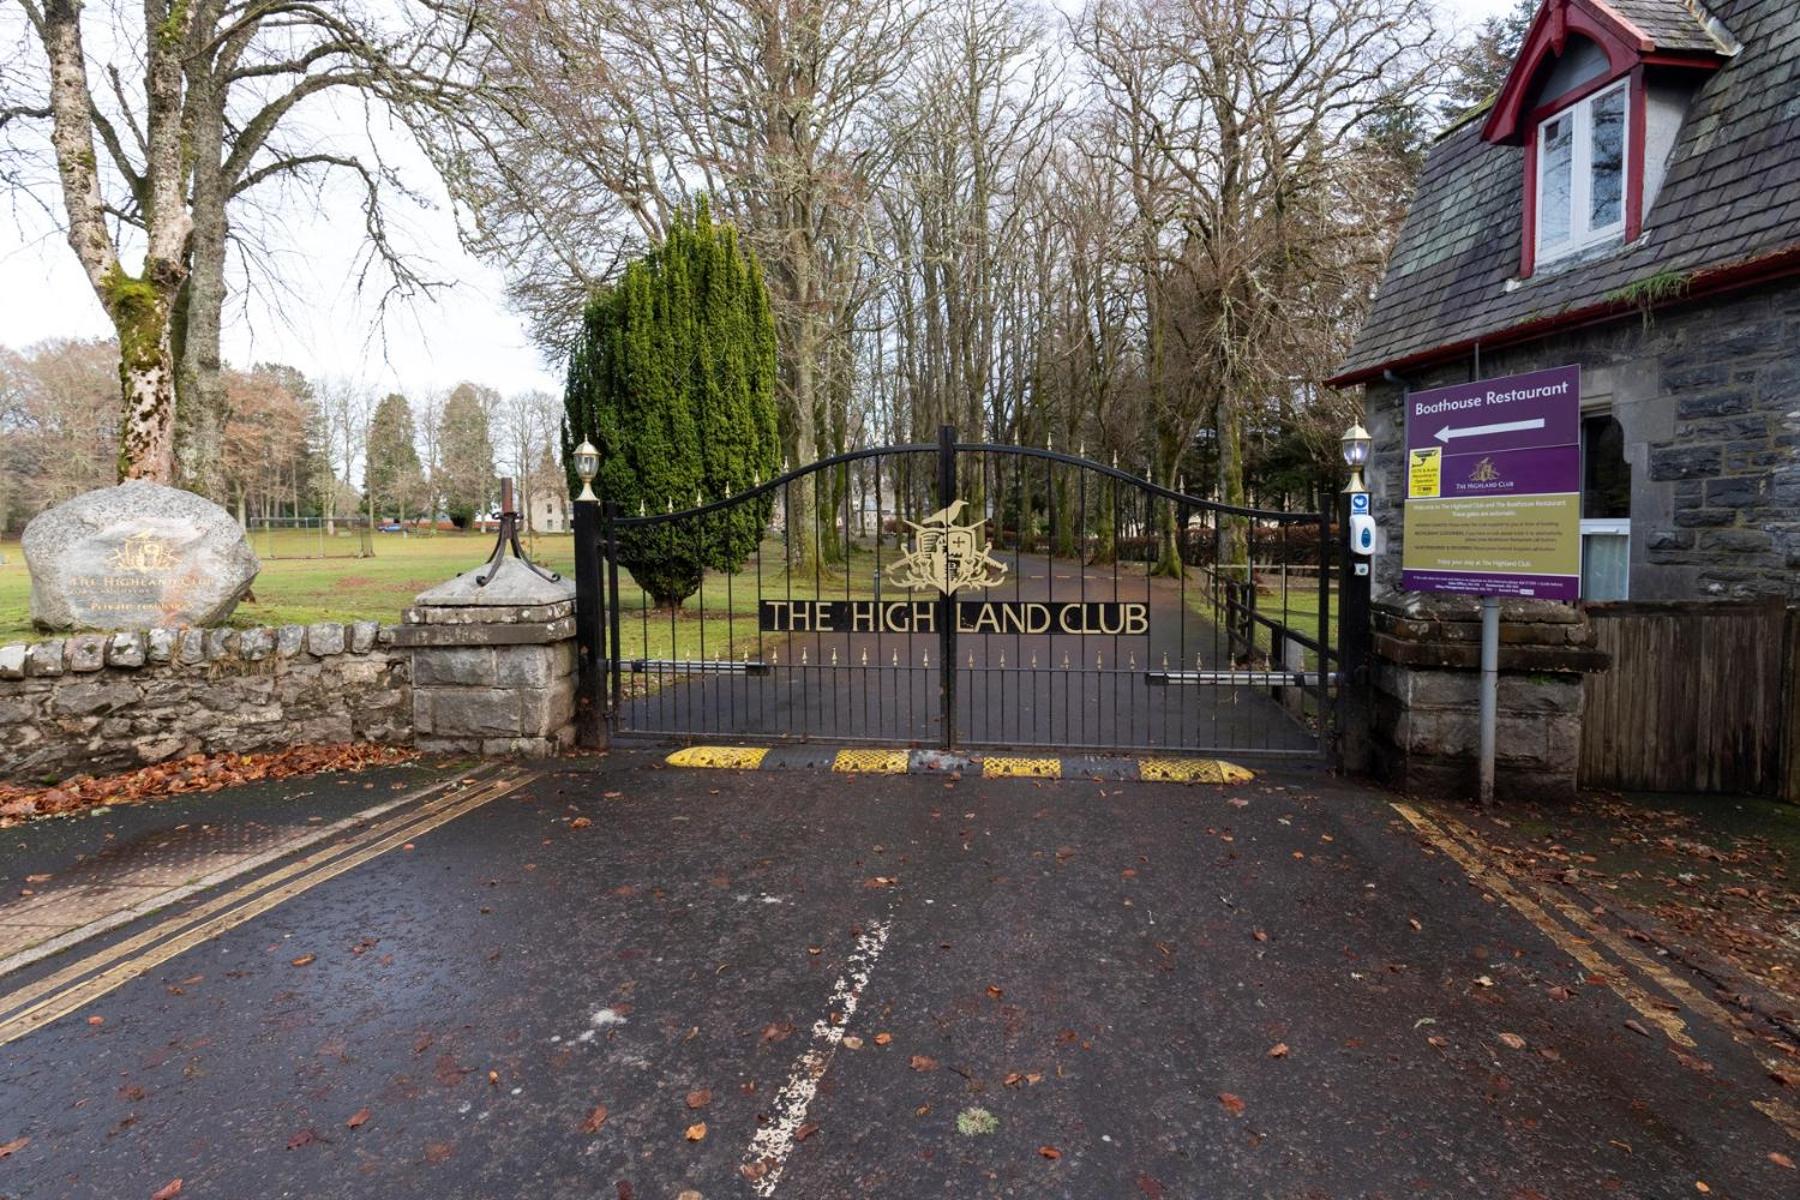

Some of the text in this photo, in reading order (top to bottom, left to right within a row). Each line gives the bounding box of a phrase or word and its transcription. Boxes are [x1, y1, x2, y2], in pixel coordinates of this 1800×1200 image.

[1415, 381, 1569, 416] Boathouse Restaurant
[765, 601, 834, 632] THE
[1059, 602, 1149, 634] CLUB
